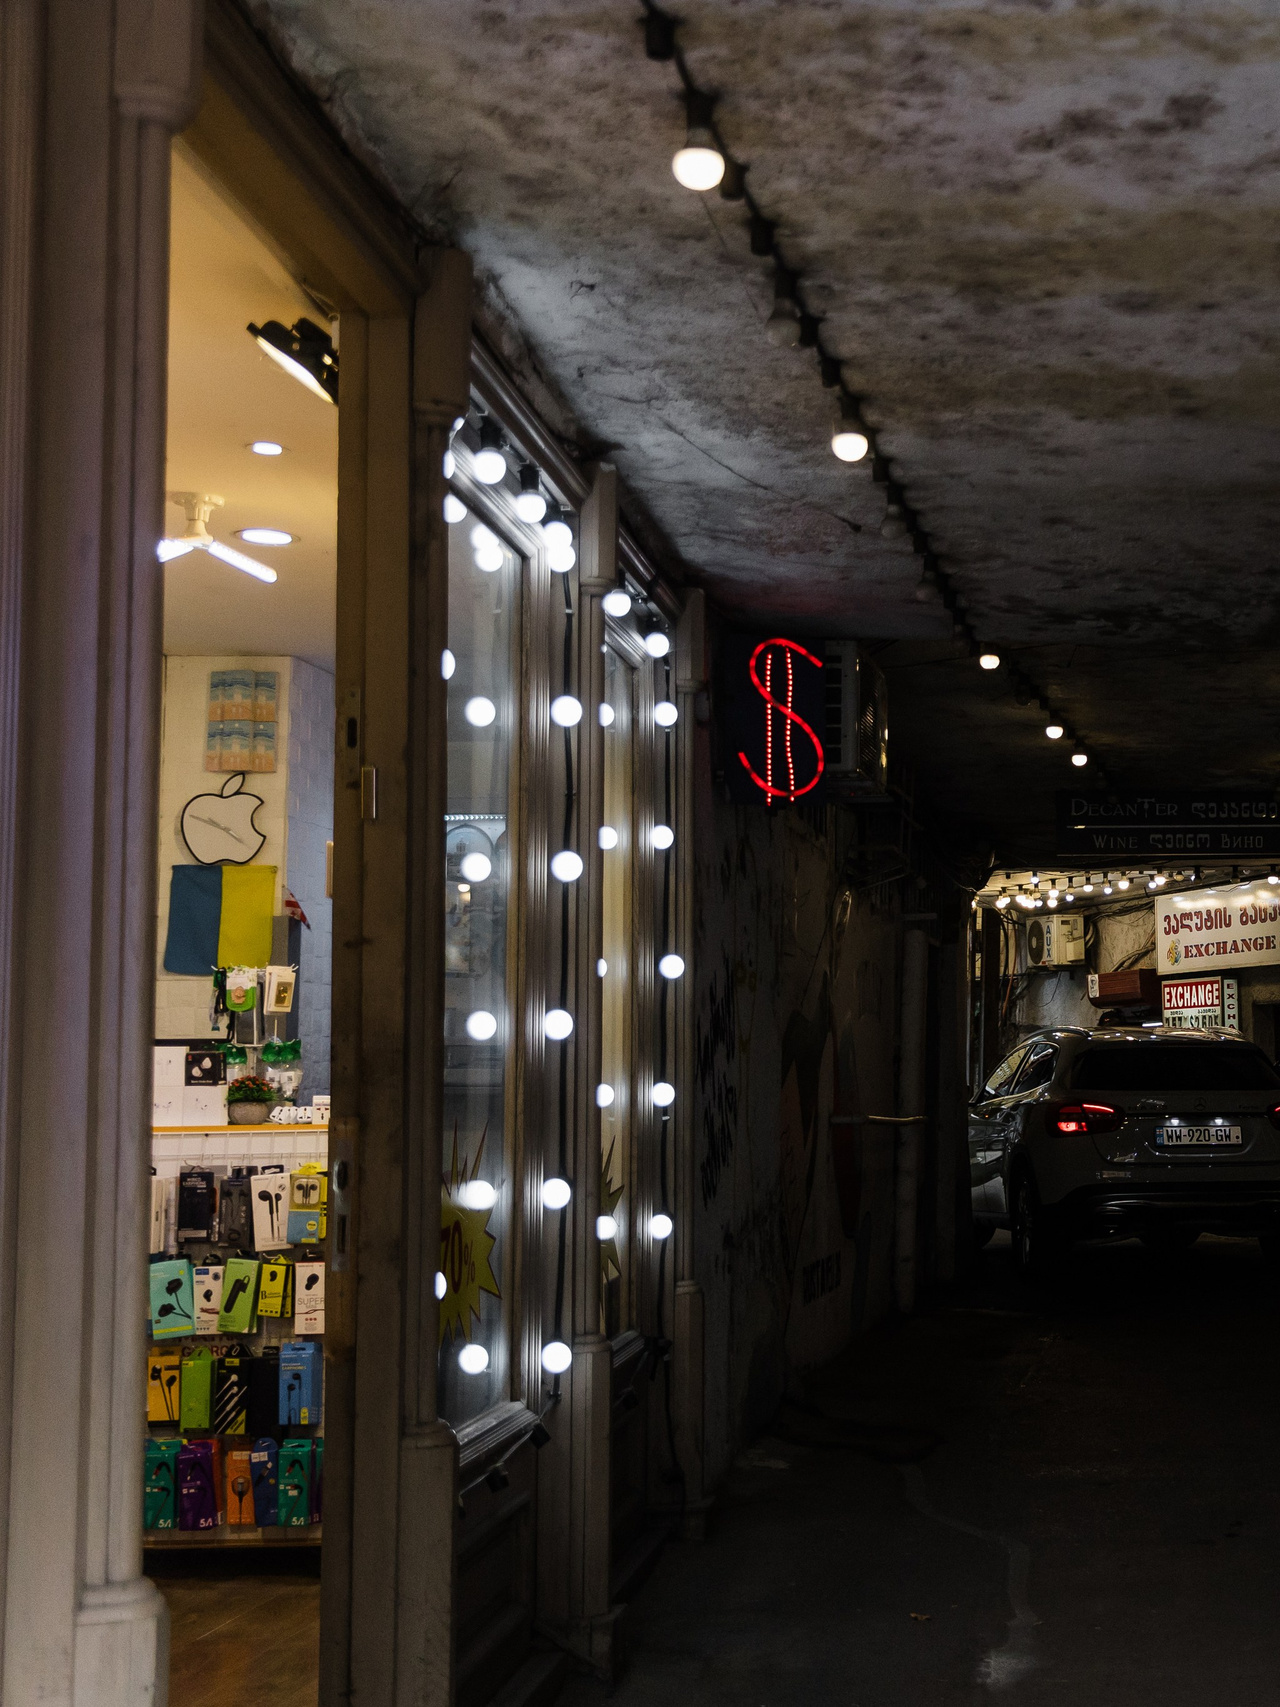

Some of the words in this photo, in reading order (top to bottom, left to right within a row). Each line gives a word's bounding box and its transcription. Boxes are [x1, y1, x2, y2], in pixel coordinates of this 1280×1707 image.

[1163, 906, 1232, 936] ვალუტის
[1183, 934, 1277, 959] EXCHANGE
[1163, 983, 1220, 1009] EXCHANGE
[1166, 1128, 1232, 1143] WW-920-GW
